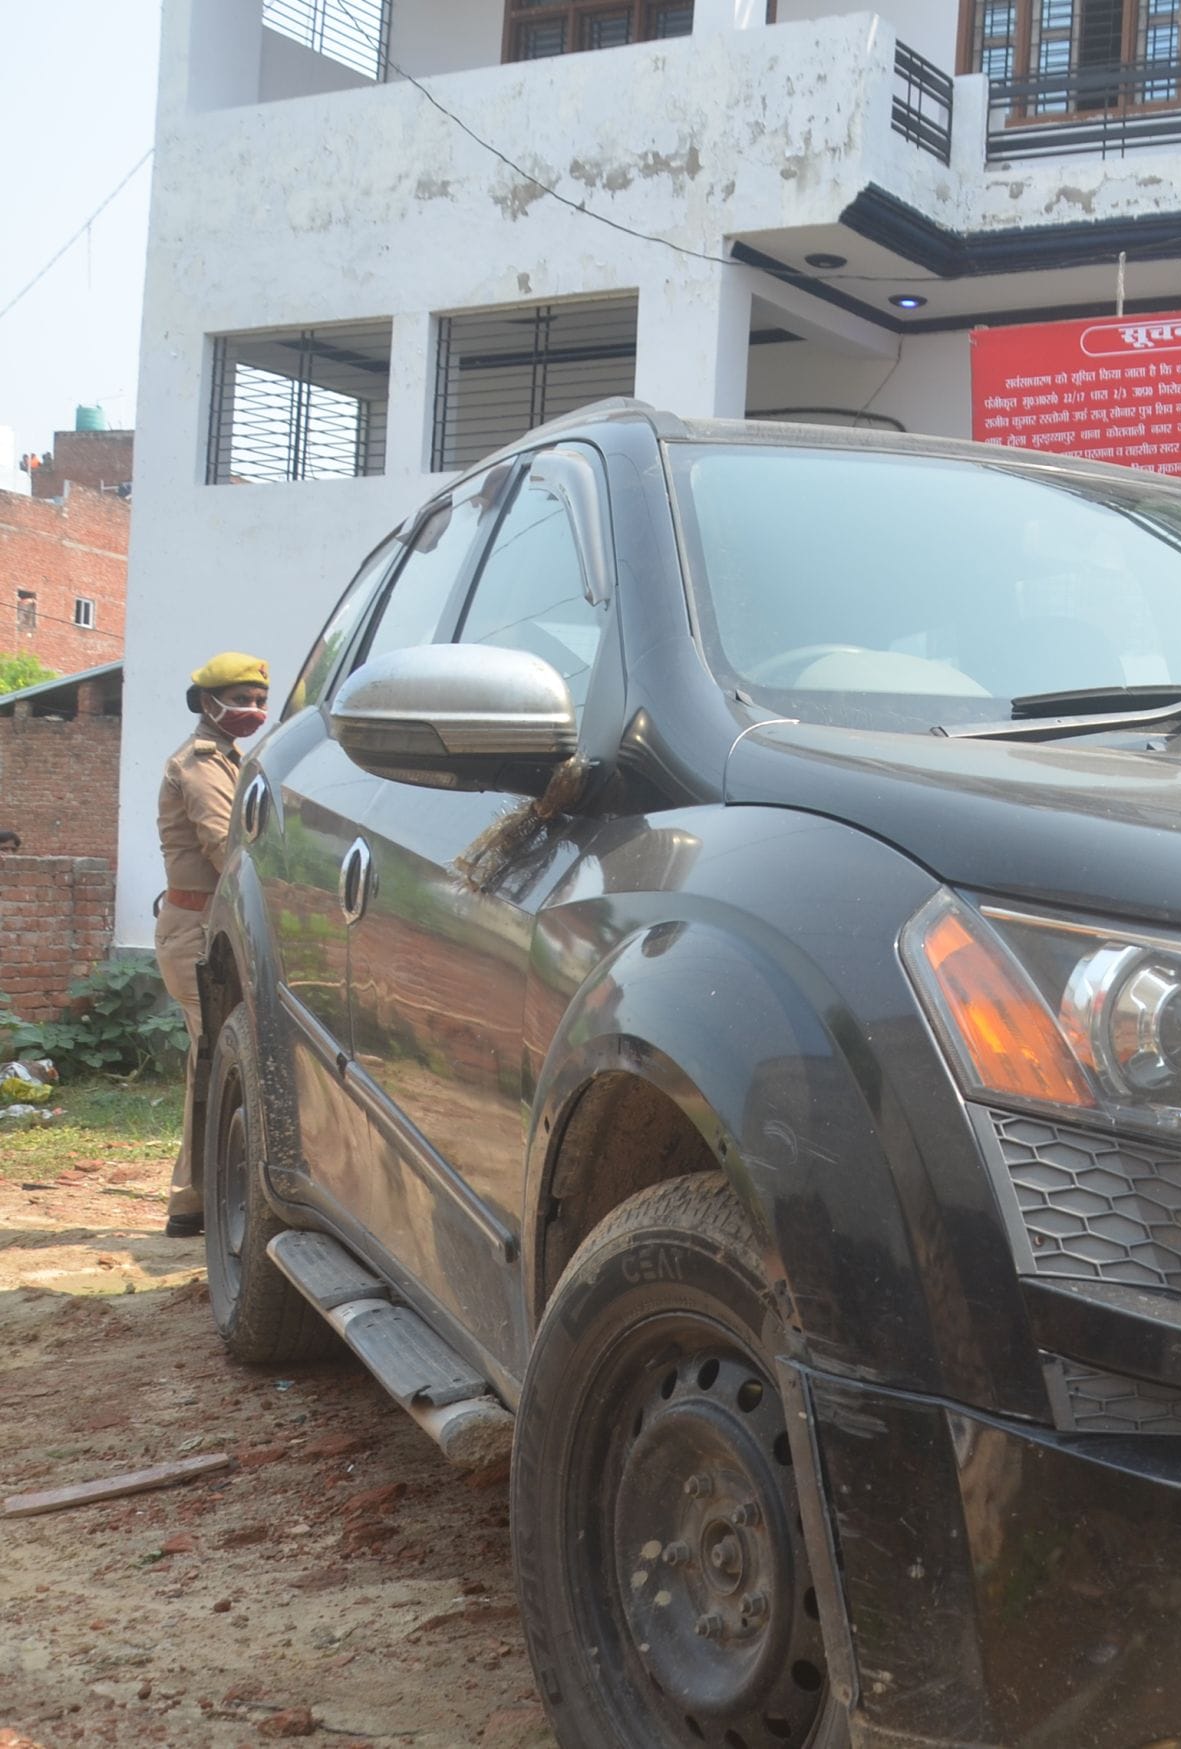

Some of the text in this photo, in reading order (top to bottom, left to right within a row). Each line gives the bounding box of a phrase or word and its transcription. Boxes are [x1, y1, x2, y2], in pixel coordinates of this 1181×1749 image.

[1055, 371, 1067, 384] को
[1071, 369, 1096, 385] सूचित
[1099, 368, 1121, 380] किया
[1124, 367, 1146, 377] जाता
[1148, 363, 1156, 377] है
[1159, 362, 1172, 375] कि
[1063, 391, 1085, 403] 22/17
[1090, 390, 1108, 400] धारा
[1113, 386, 1127, 399] 2/3
[1012, 415, 1036, 429] कुमार
[1039, 410, 1069, 424] रस्तोगी
[1090, 407, 1108, 422] राजू
[1138, 406, 1152, 419] पुत्र
[1155, 402, 1173, 414] शिव
[1081, 430, 1100, 439] थाना
[1106, 423, 1145, 437] कोतवाली
[1151, 424, 1172, 434] नगर
[1116, 447, 1123, 456] व
[1125, 442, 1157, 456] तहसील
[1159, 444, 1181, 454] सदर
